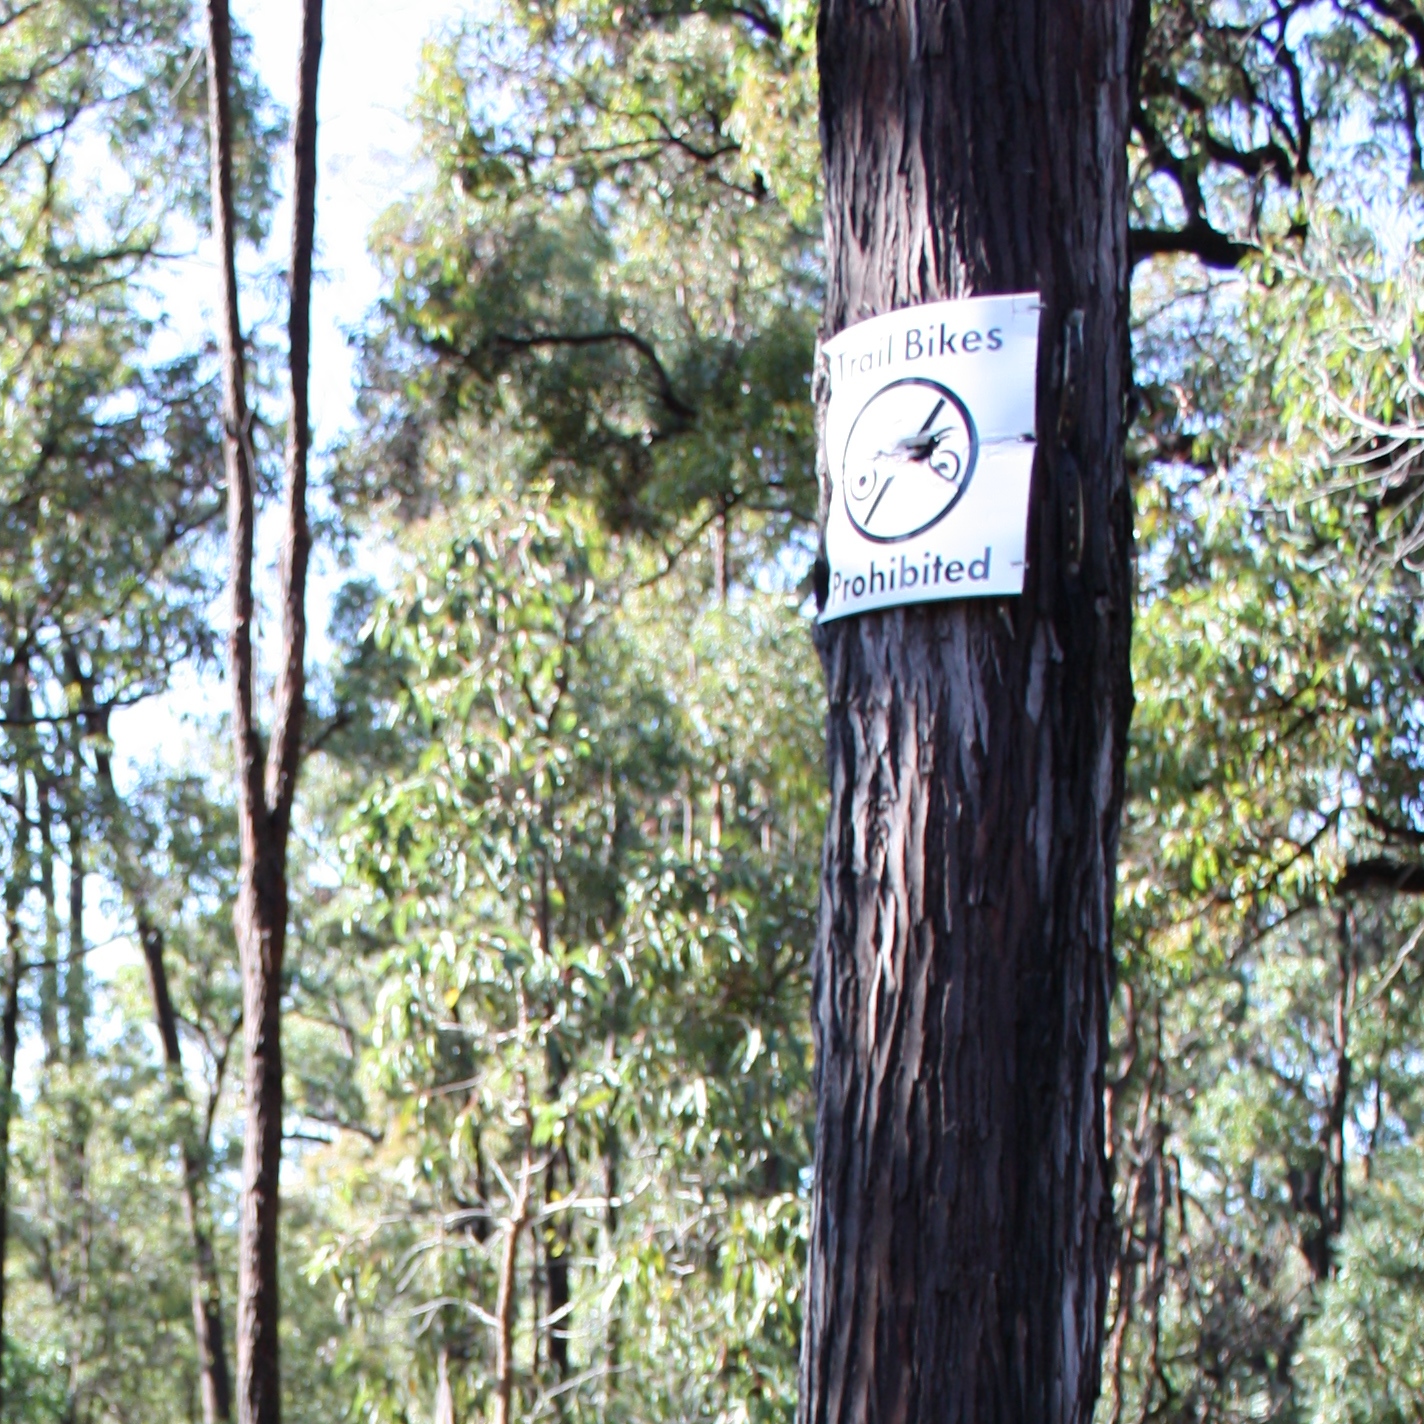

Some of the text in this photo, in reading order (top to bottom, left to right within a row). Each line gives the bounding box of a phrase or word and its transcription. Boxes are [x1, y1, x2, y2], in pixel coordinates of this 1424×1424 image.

[838, 323, 1004, 382] Trail Bikes
[831, 546, 993, 606] Prohibited
